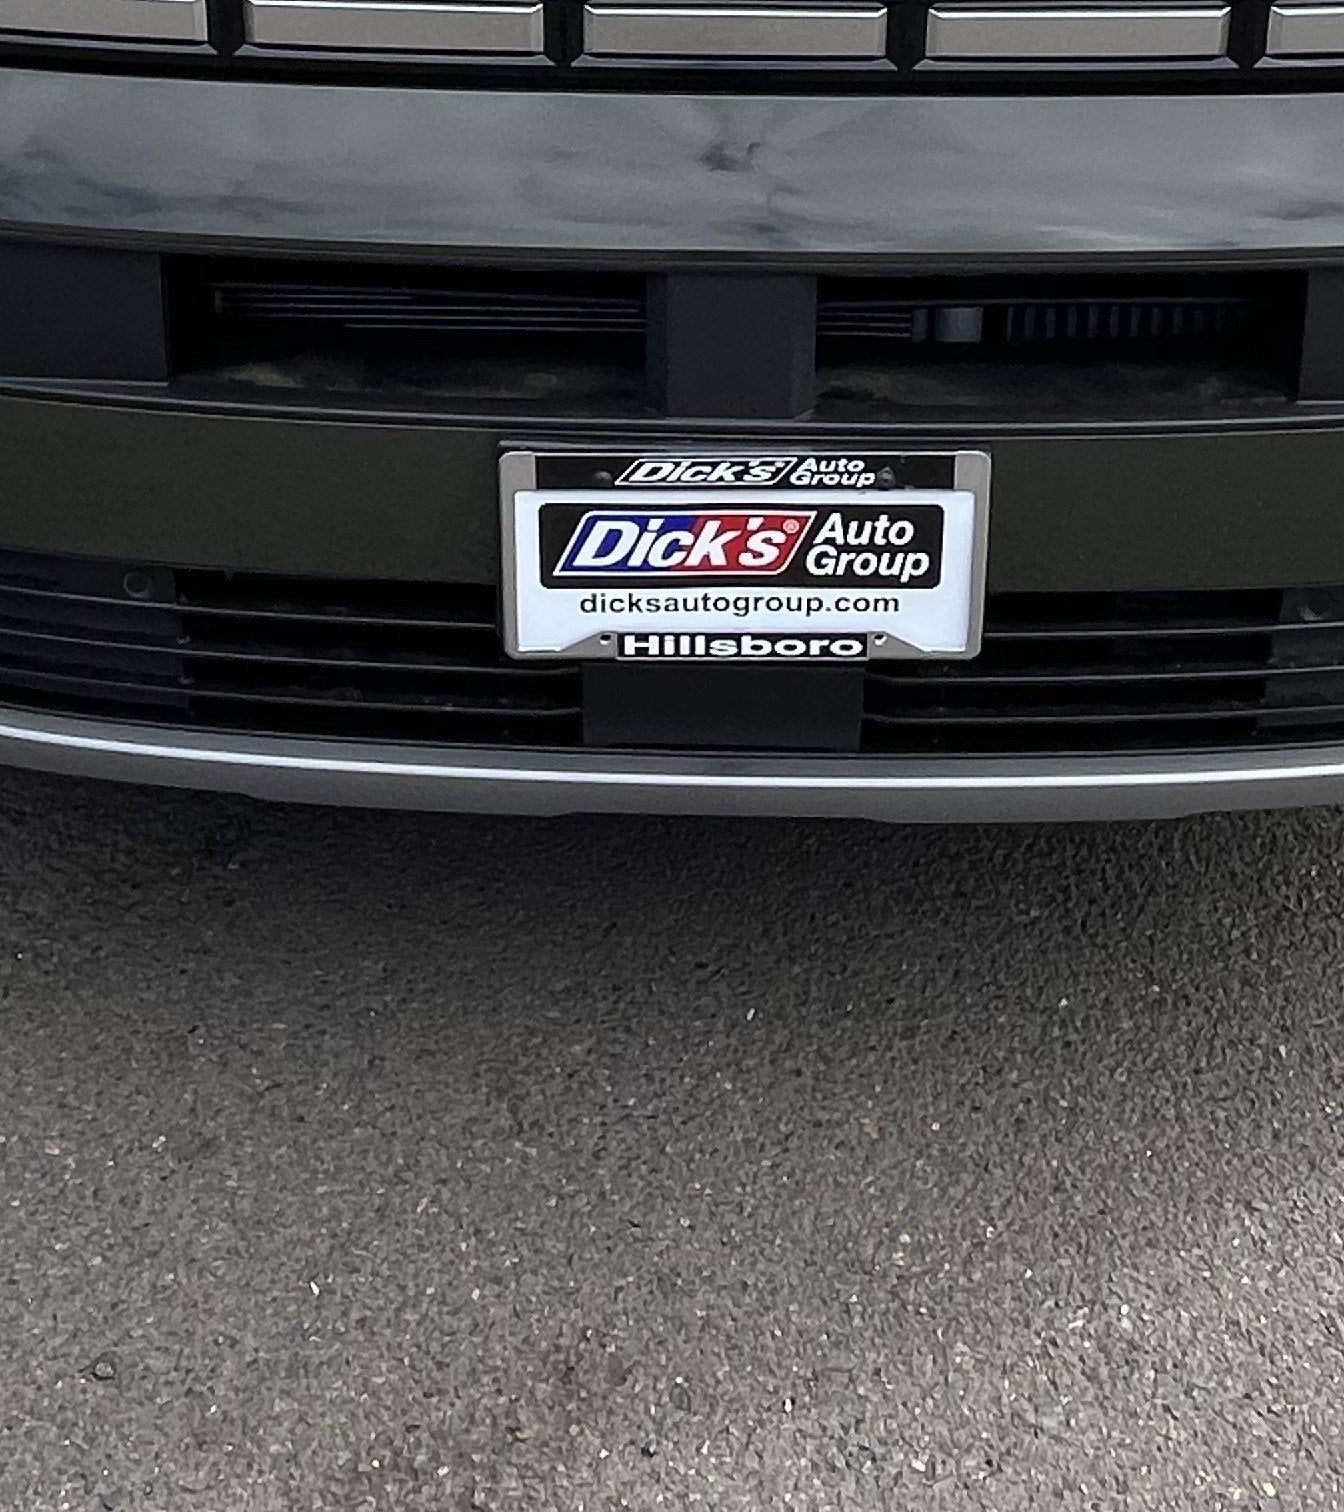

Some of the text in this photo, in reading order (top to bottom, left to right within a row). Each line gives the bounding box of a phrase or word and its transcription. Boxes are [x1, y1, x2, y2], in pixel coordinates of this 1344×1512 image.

[798, 457, 865, 473] Auto
[789, 471, 876, 488] Group
[813, 512, 915, 546] Auto
[805, 544, 931, 583] Group
[579, 592, 900, 617] dicksautogroup.com
[623, 633, 864, 657] Hillsboro
